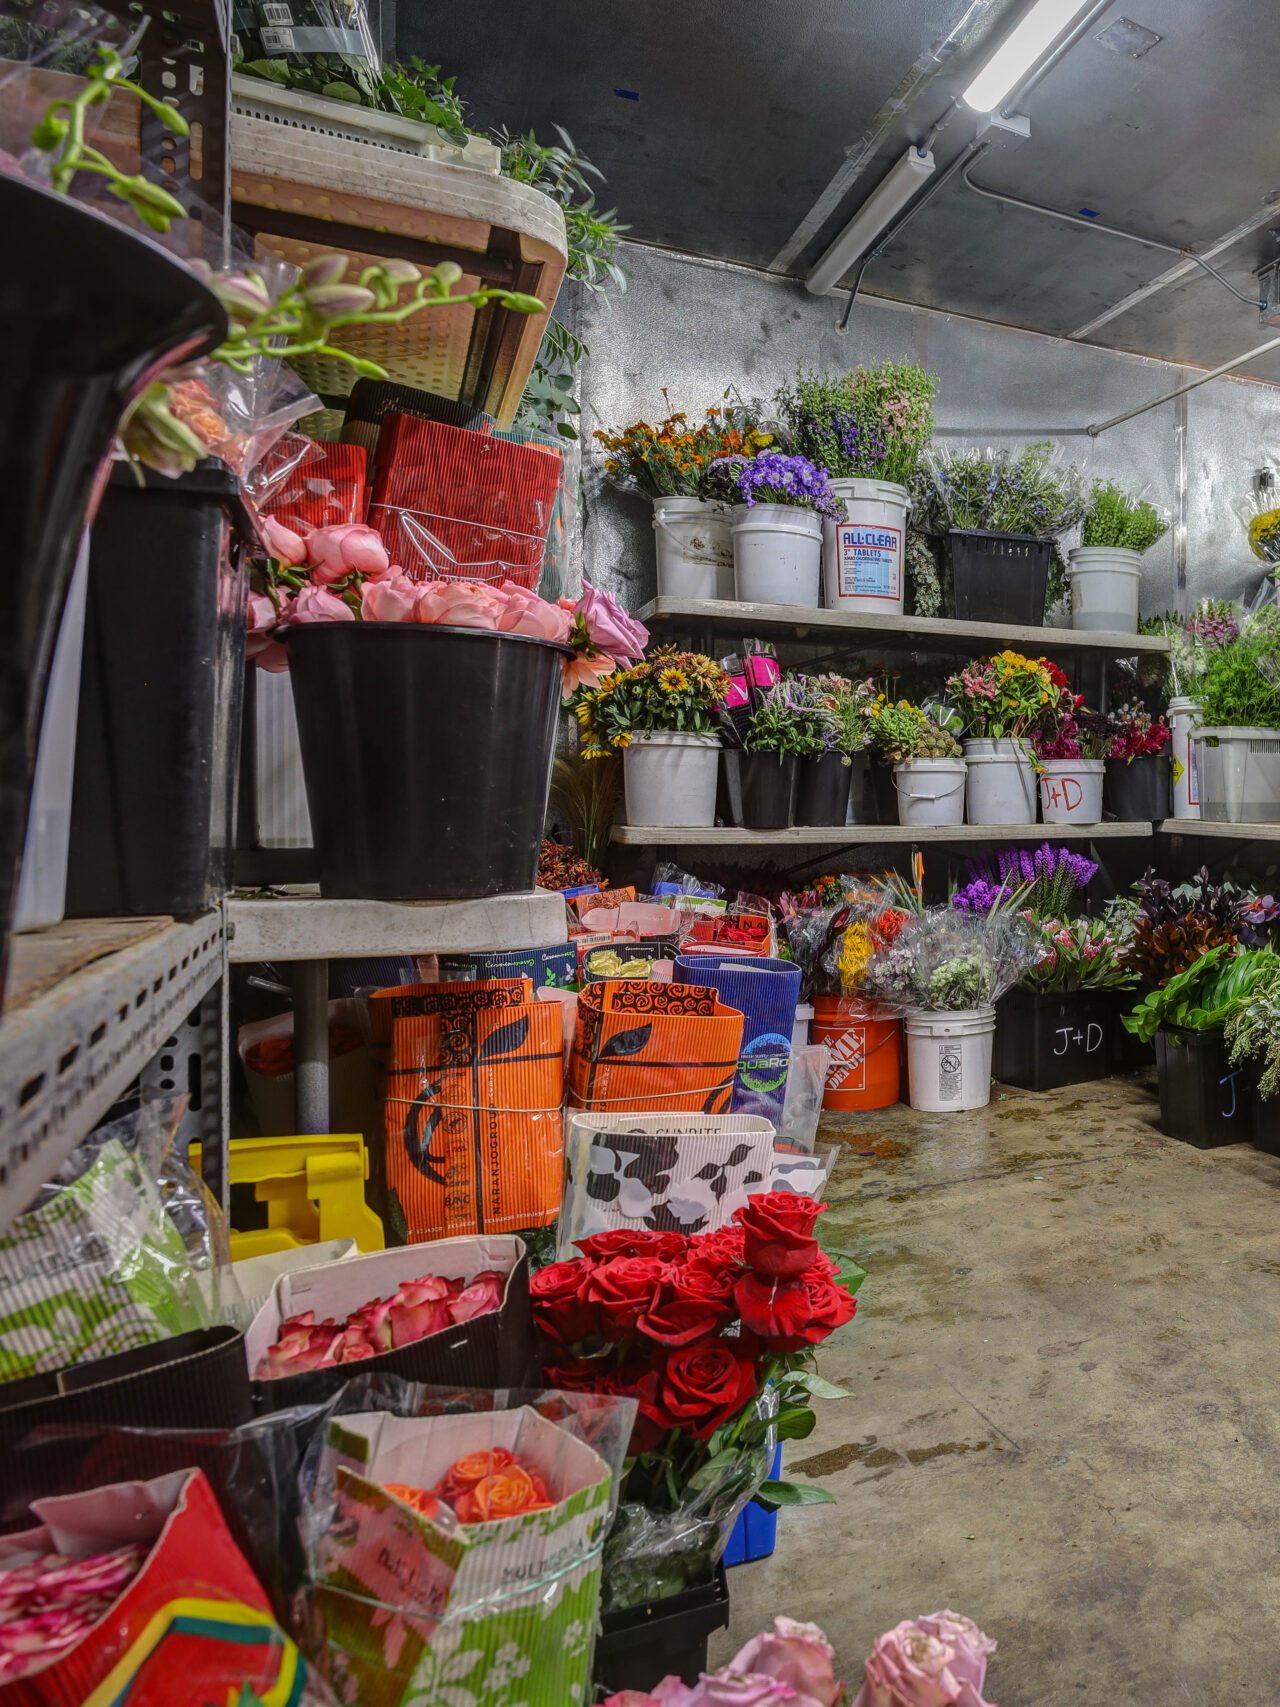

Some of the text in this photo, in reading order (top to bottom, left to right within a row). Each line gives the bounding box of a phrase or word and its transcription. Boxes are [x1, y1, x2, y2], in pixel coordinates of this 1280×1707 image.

[854, 549, 881, 558] TABLETS
[1041, 778, 1083, 811] J+D
[1053, 1023, 1103, 1055] J+D
